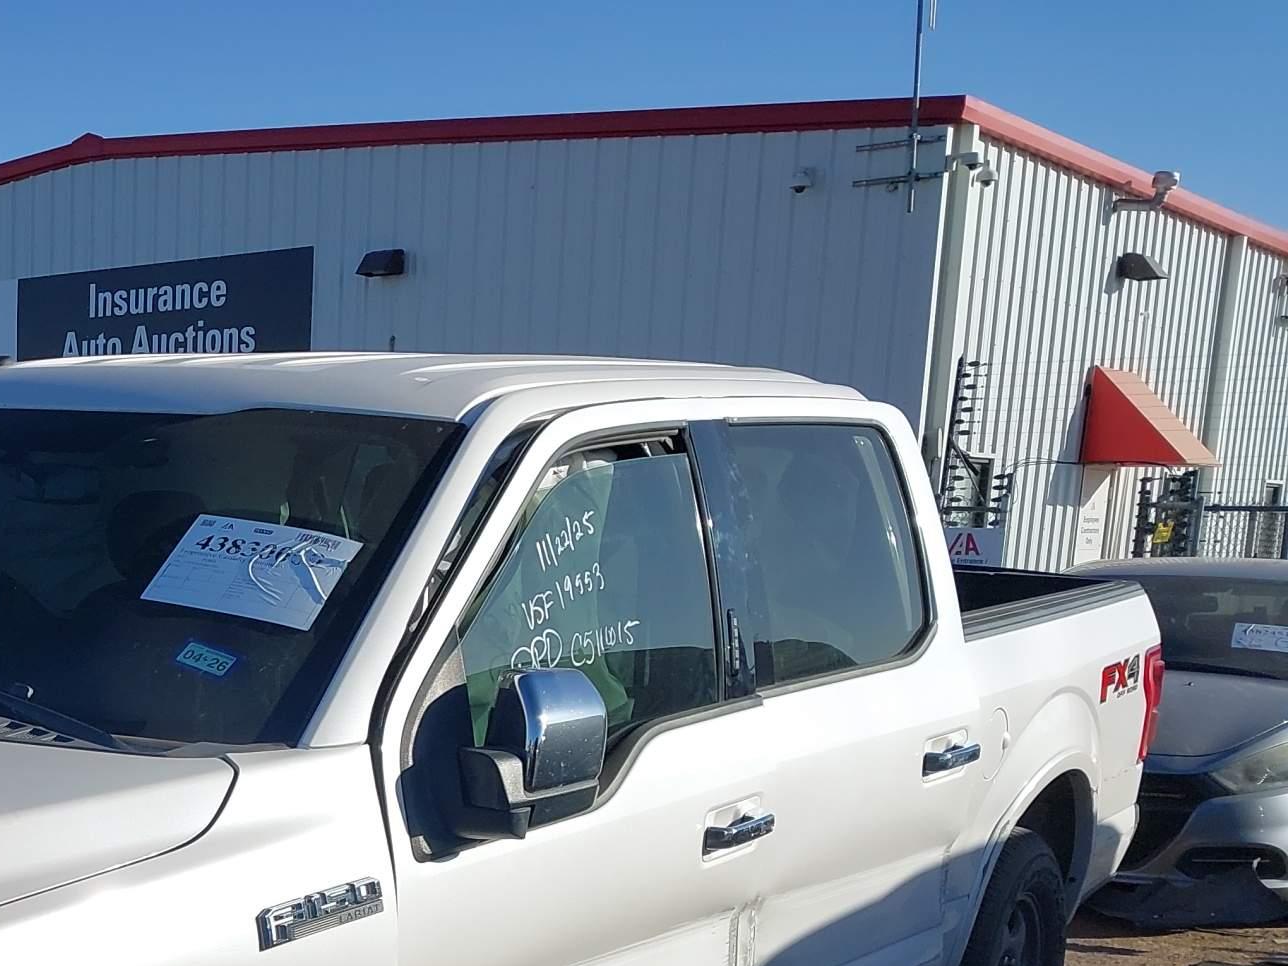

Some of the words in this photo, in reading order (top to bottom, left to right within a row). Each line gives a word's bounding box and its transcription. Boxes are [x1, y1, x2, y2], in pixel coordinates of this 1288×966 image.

[88, 279, 227, 318] Insurance
[62, 331, 122, 358] Auto
[131, 320, 256, 354] Auctions
[536, 510, 595, 572] 11/22/25
[1100, 653, 1140, 704] FX4
[255, 876, 383, 952] F-150
[339, 902, 381, 925] LARIAT
